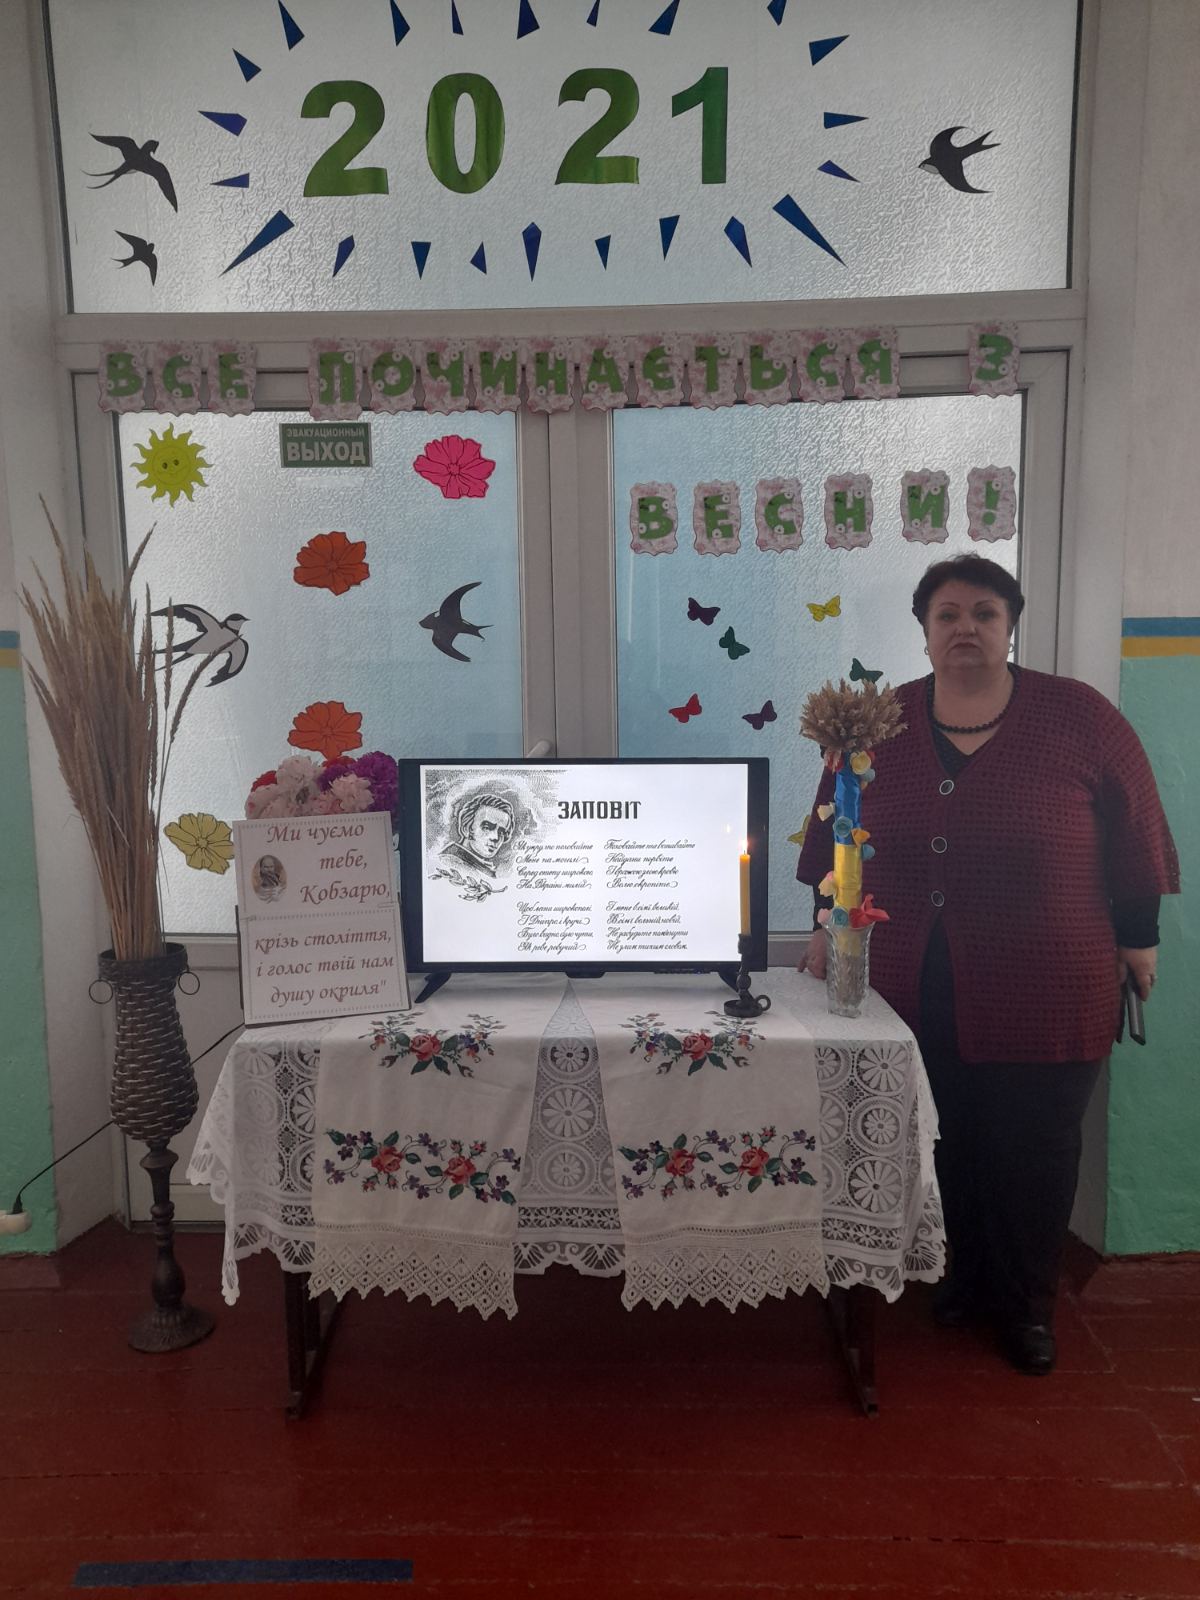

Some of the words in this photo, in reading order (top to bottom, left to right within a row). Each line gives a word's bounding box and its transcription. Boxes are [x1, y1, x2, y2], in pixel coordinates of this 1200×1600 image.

[301, 67, 728, 197] 2021
[106, 351, 248, 398] ВСЕ
[319, 339, 893, 404] ПОЧИНАЄТЬСЯ
[977, 333, 1014, 381] З
[286, 427, 365, 438] ЭВАКУАЦИОННЫЙ
[286, 441, 366, 465] ВЫХОД
[558, 800, 642, 820] ЗАПОВІТ
[267, 825, 301, 844] Ми
[307, 823, 365, 845] чуємо
[319, 848, 368, 870] тебе,
[299, 881, 391, 905] Кобзарю,
[254, 932, 299, 954] крізь
[303, 928, 392, 948] століття,
[256, 962, 263, 977] і
[267, 962, 312, 977] голос
[317, 955, 356, 972] твій
[361, 956, 394, 969] нам
[270, 985, 315, 1008] душу
[319, 980, 387, 1003] окриля"
